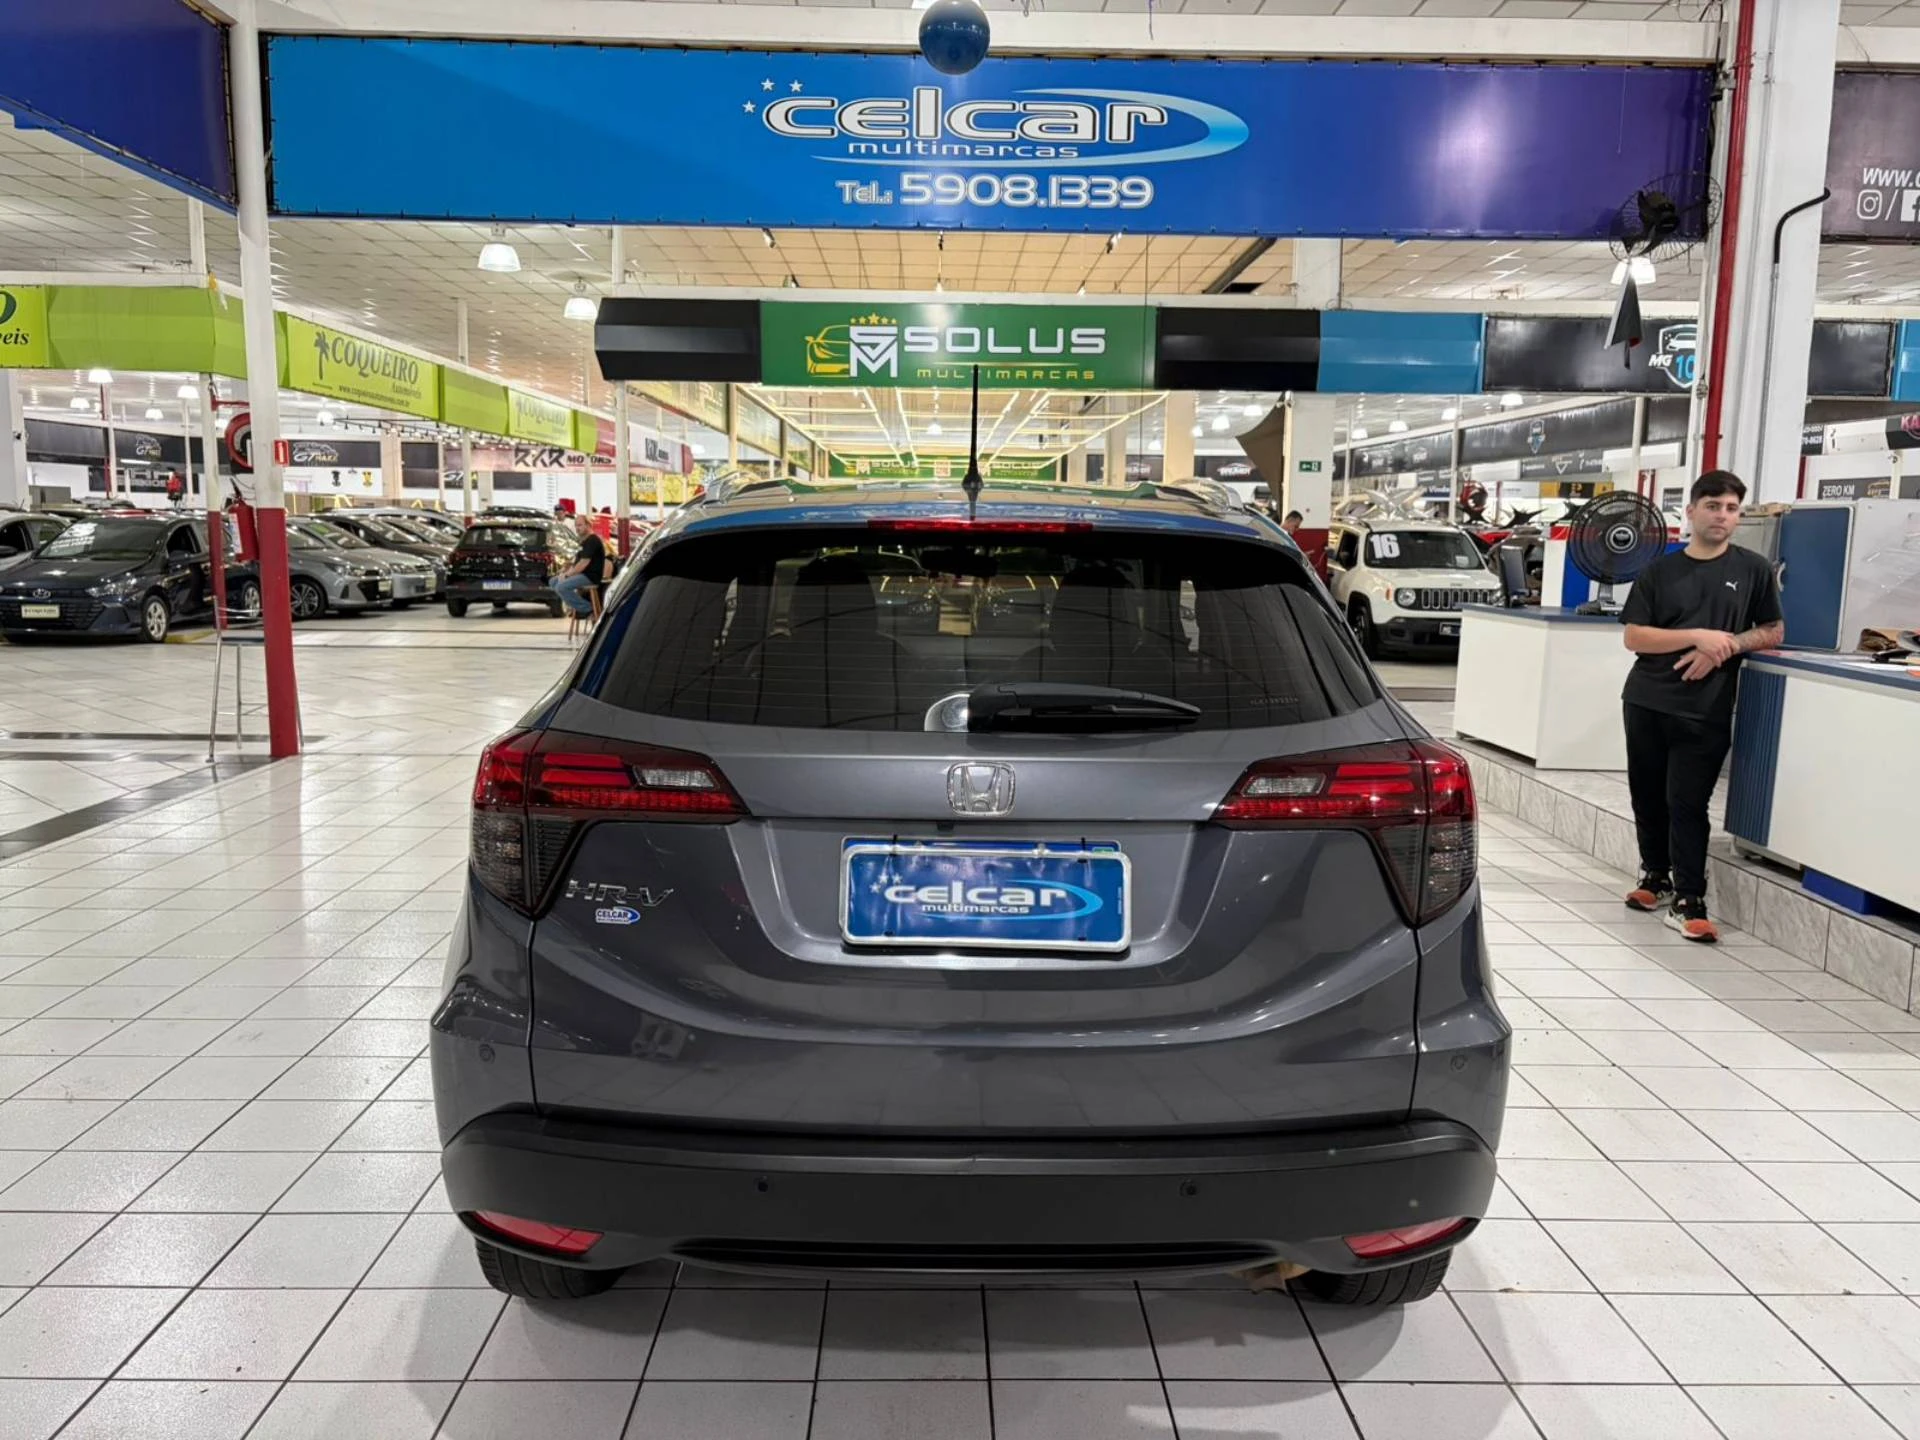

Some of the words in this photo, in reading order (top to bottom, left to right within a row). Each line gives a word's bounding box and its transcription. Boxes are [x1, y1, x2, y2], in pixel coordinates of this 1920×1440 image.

[762, 85, 1168, 144] celcar
[848, 140, 1080, 159] multimarcas
[900, 173, 1154, 209] 5908.1339
[903, 327, 1107, 355] SOLUS
[331, 336, 419, 385] COQUEIRO
[1648, 354, 1673, 367] MG
[1822, 485, 1842, 497] ZERO
[1842, 484, 1855, 496] KM
[1370, 533, 1401, 559] 16
[565, 879, 674, 907] HR-V
[884, 880, 1068, 907] celcar
[921, 903, 1030, 914] multimarcas
